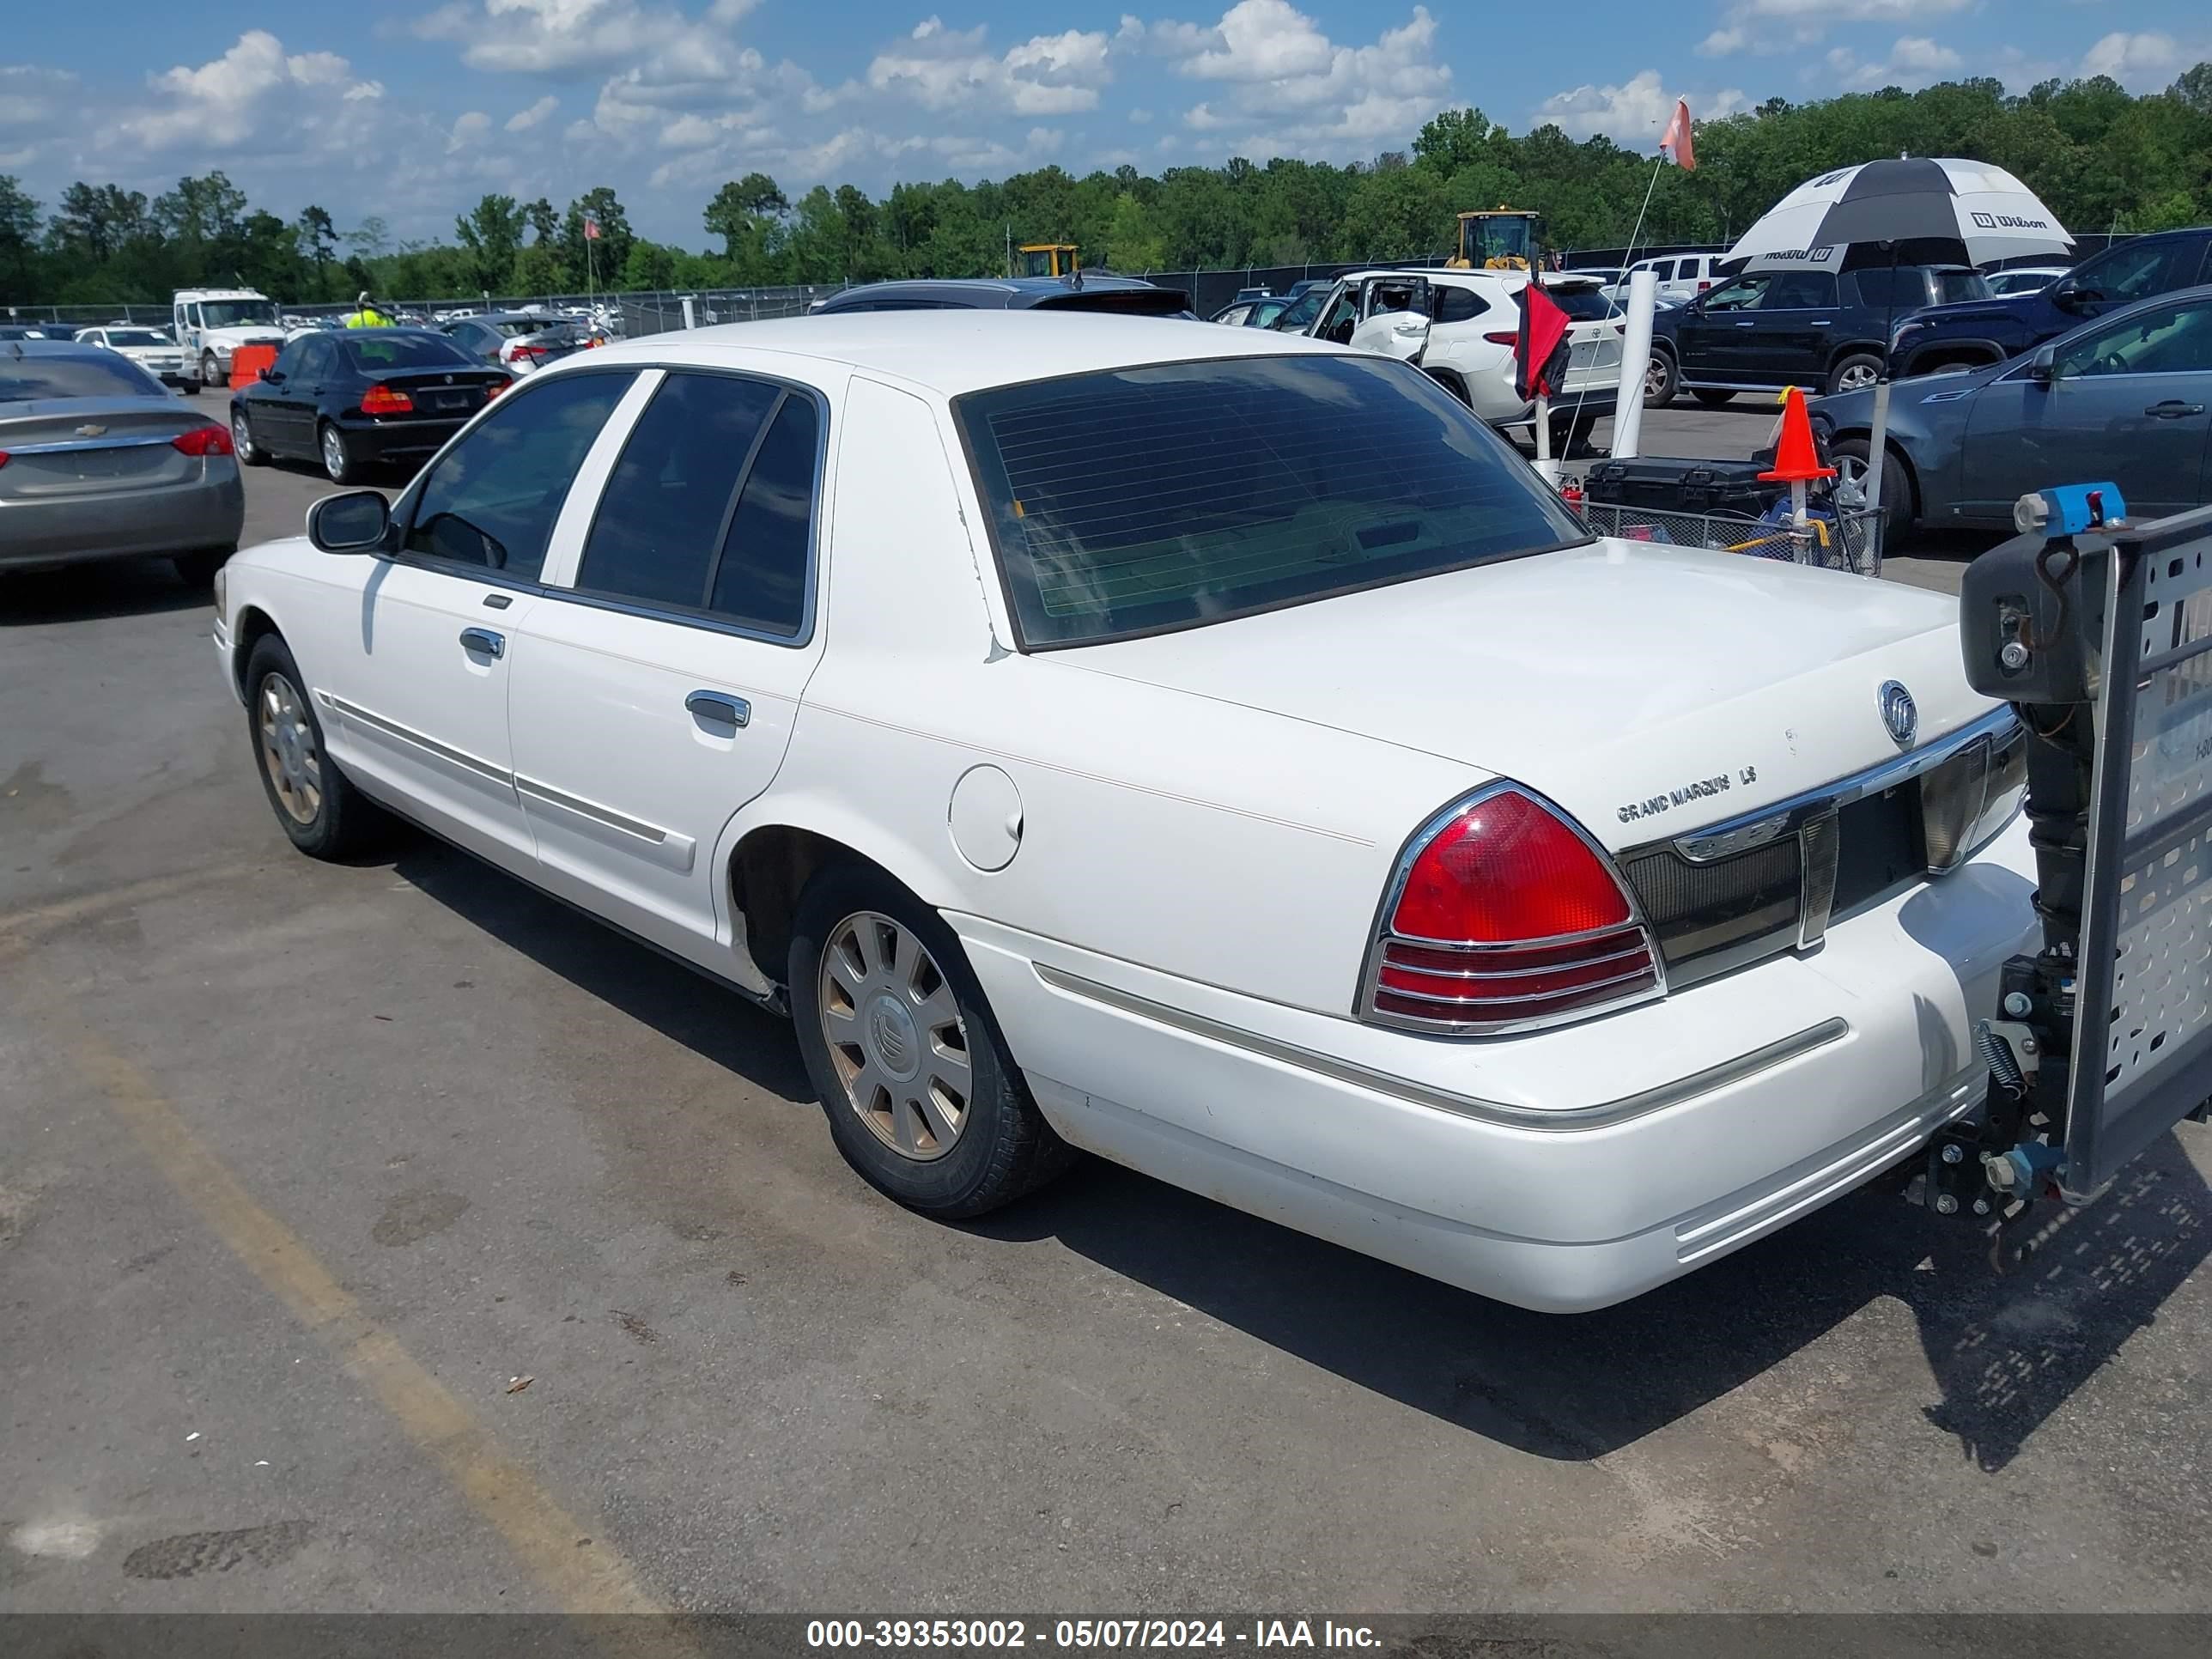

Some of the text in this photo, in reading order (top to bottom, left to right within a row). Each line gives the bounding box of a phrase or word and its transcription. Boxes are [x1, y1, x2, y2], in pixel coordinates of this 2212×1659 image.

[1996, 216, 2047, 228] Wilson
[1617, 766, 1757, 823] GRAND MARQUIS LS
